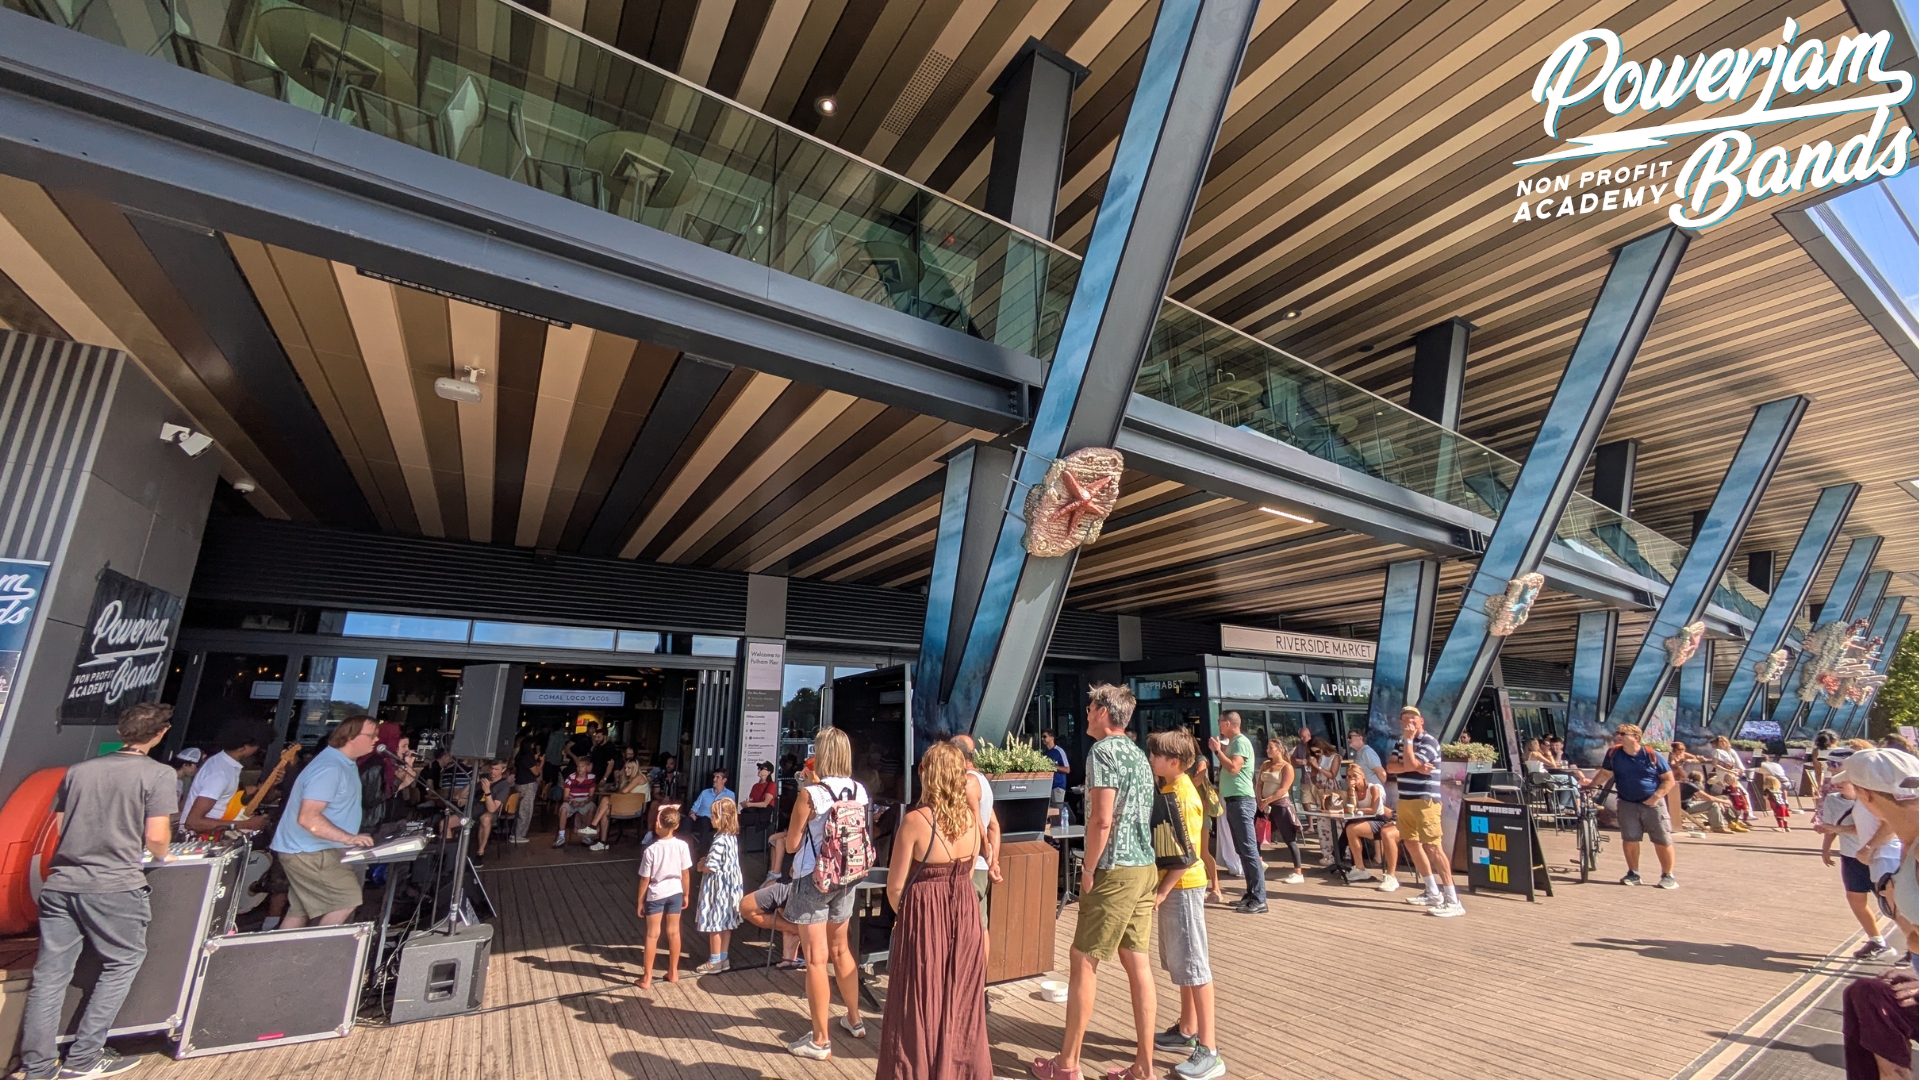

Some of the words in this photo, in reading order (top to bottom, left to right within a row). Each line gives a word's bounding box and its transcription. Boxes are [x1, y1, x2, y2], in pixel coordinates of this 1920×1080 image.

[91, 599, 170, 654] Powerjam
[1275, 635, 1330, 655] RIVERSIDE
[1331, 641, 1371, 658] MARKET
[73, 674, 90, 685] NON
[90, 669, 115, 681] PROFIT
[105, 652, 164, 704] Bands
[1140, 680, 1185, 691] ALPHABET
[67, 682, 111, 699] ACADEMY
